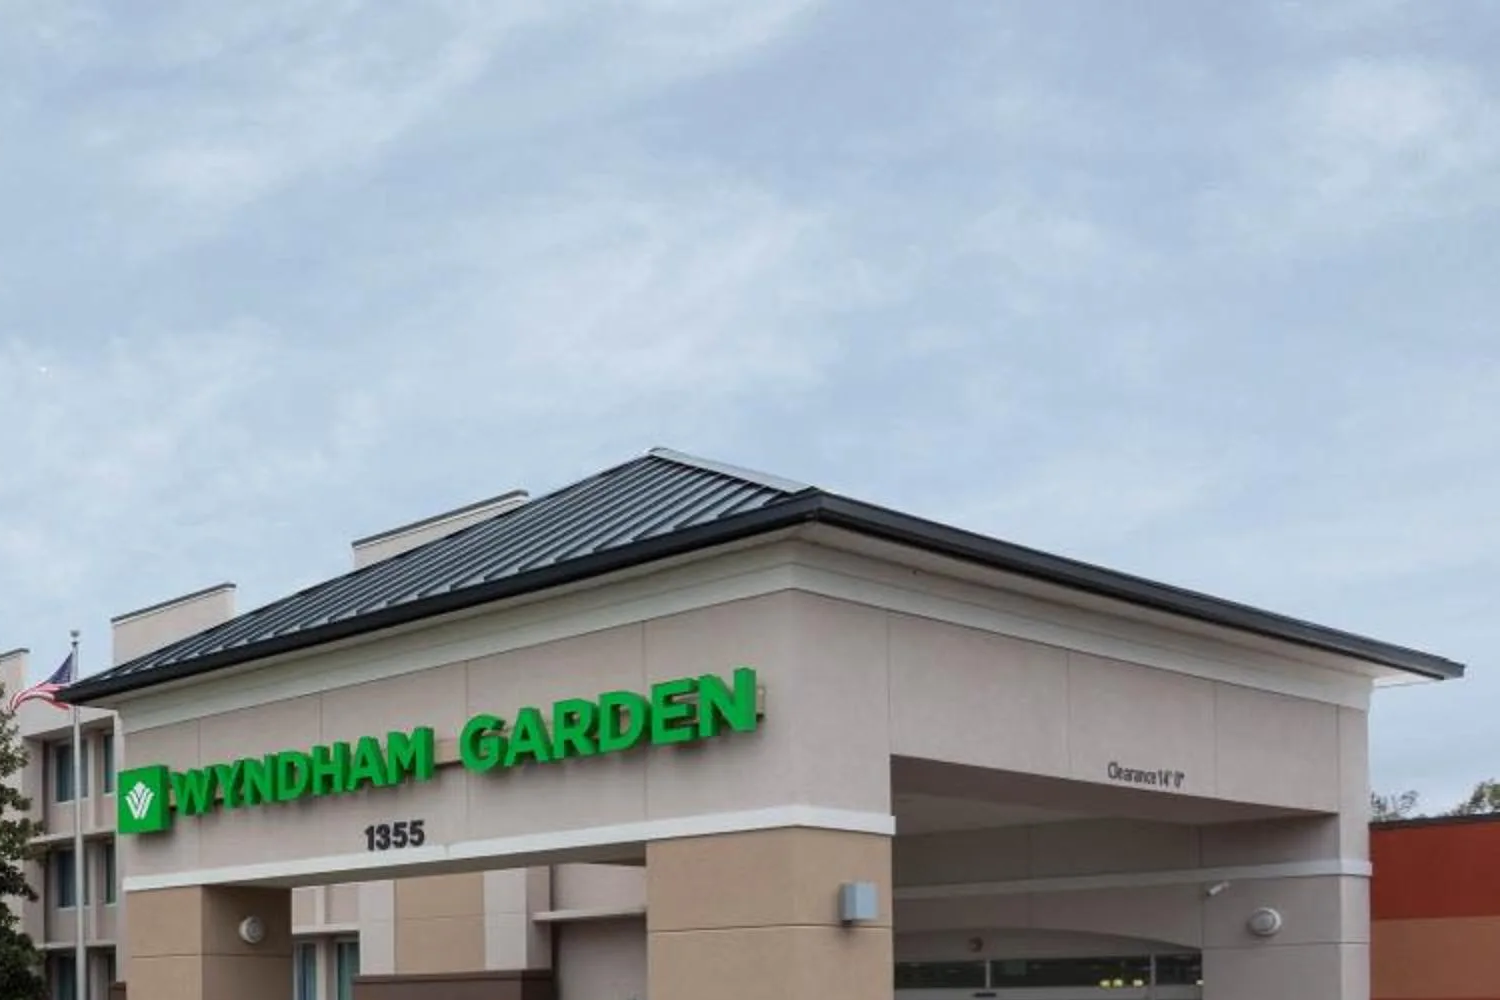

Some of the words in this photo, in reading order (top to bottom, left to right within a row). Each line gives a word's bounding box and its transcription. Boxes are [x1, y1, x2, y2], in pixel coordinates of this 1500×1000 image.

[171, 726, 435, 816] WYNDHAM
[459, 667, 757, 774] GARDEN
[1107, 761, 1157, 785] Clearance
[364, 819, 425, 852] 1355
